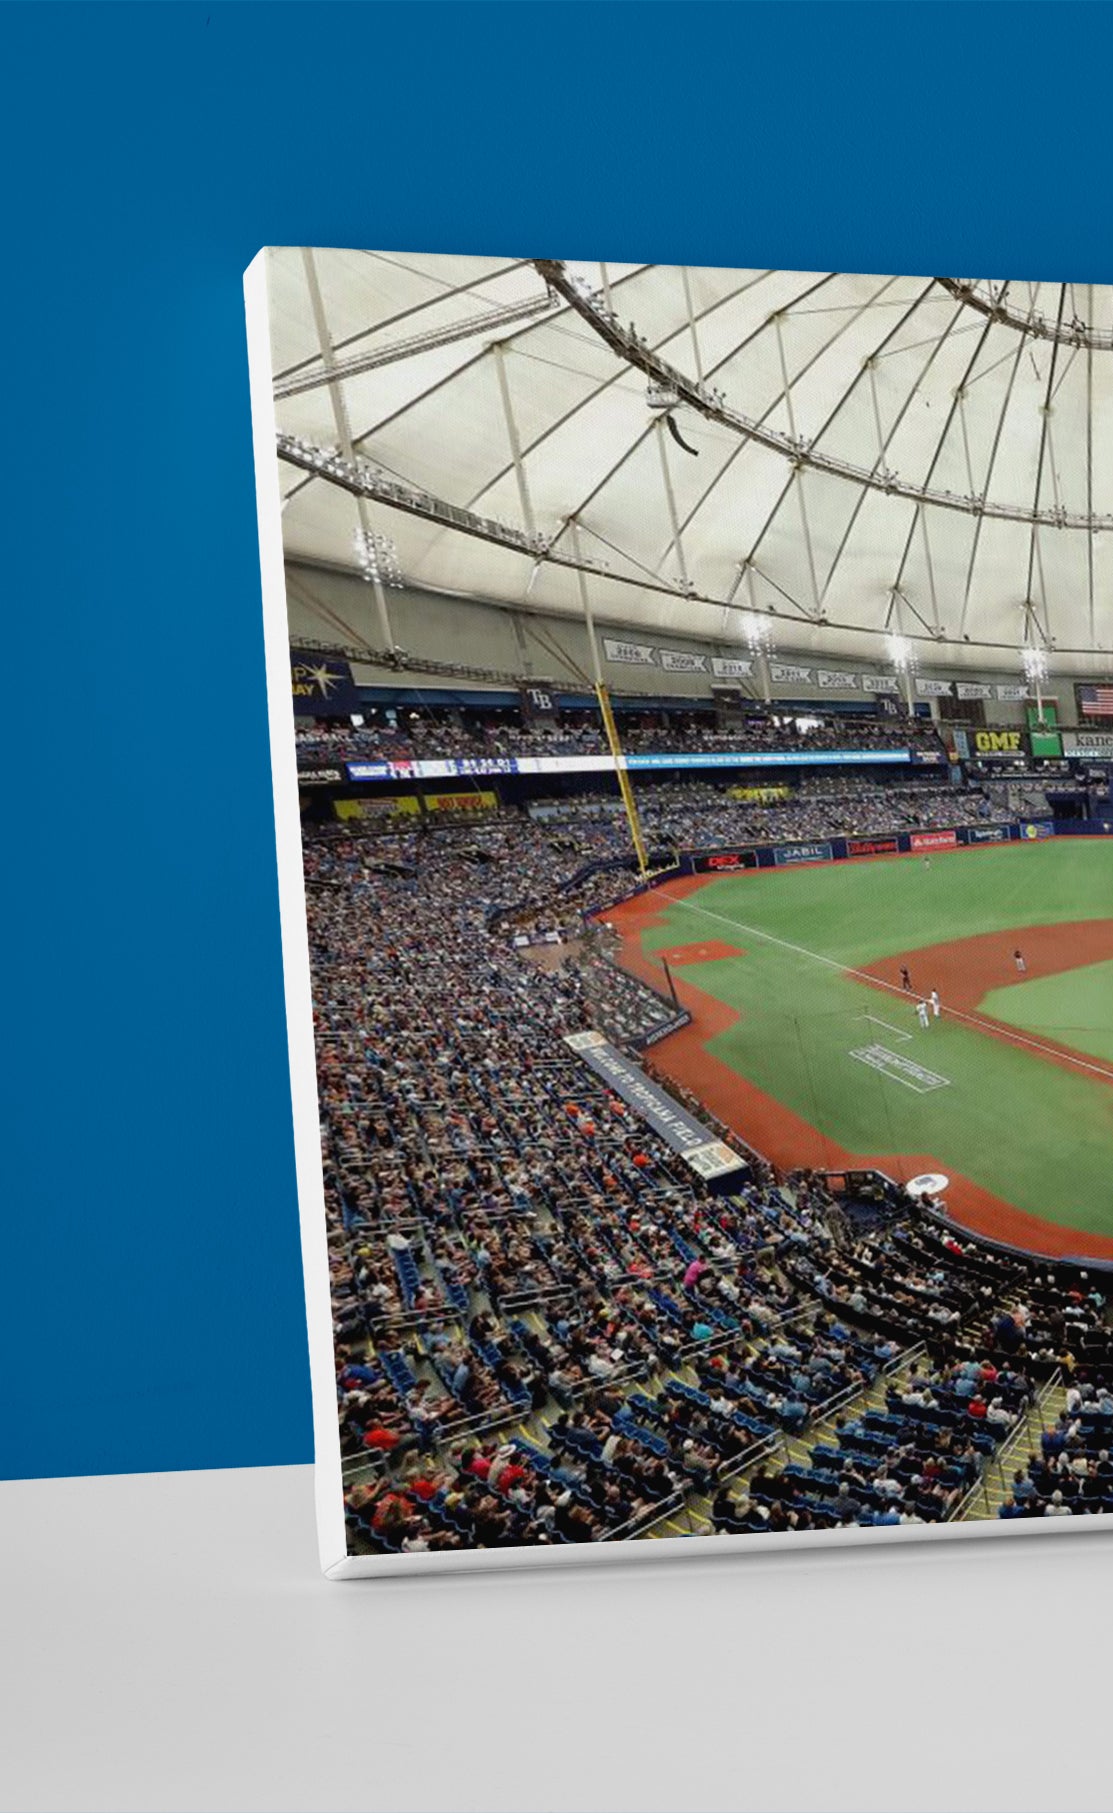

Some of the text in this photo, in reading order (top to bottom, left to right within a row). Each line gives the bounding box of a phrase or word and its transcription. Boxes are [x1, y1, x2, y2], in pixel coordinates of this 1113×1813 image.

[526, 689, 553, 709] TB
[975, 731, 1021, 751] GMF
[708, 854, 740, 866] DEX
[783, 846, 823, 857] JABIL
[669, 1121, 703, 1146] FIELD
